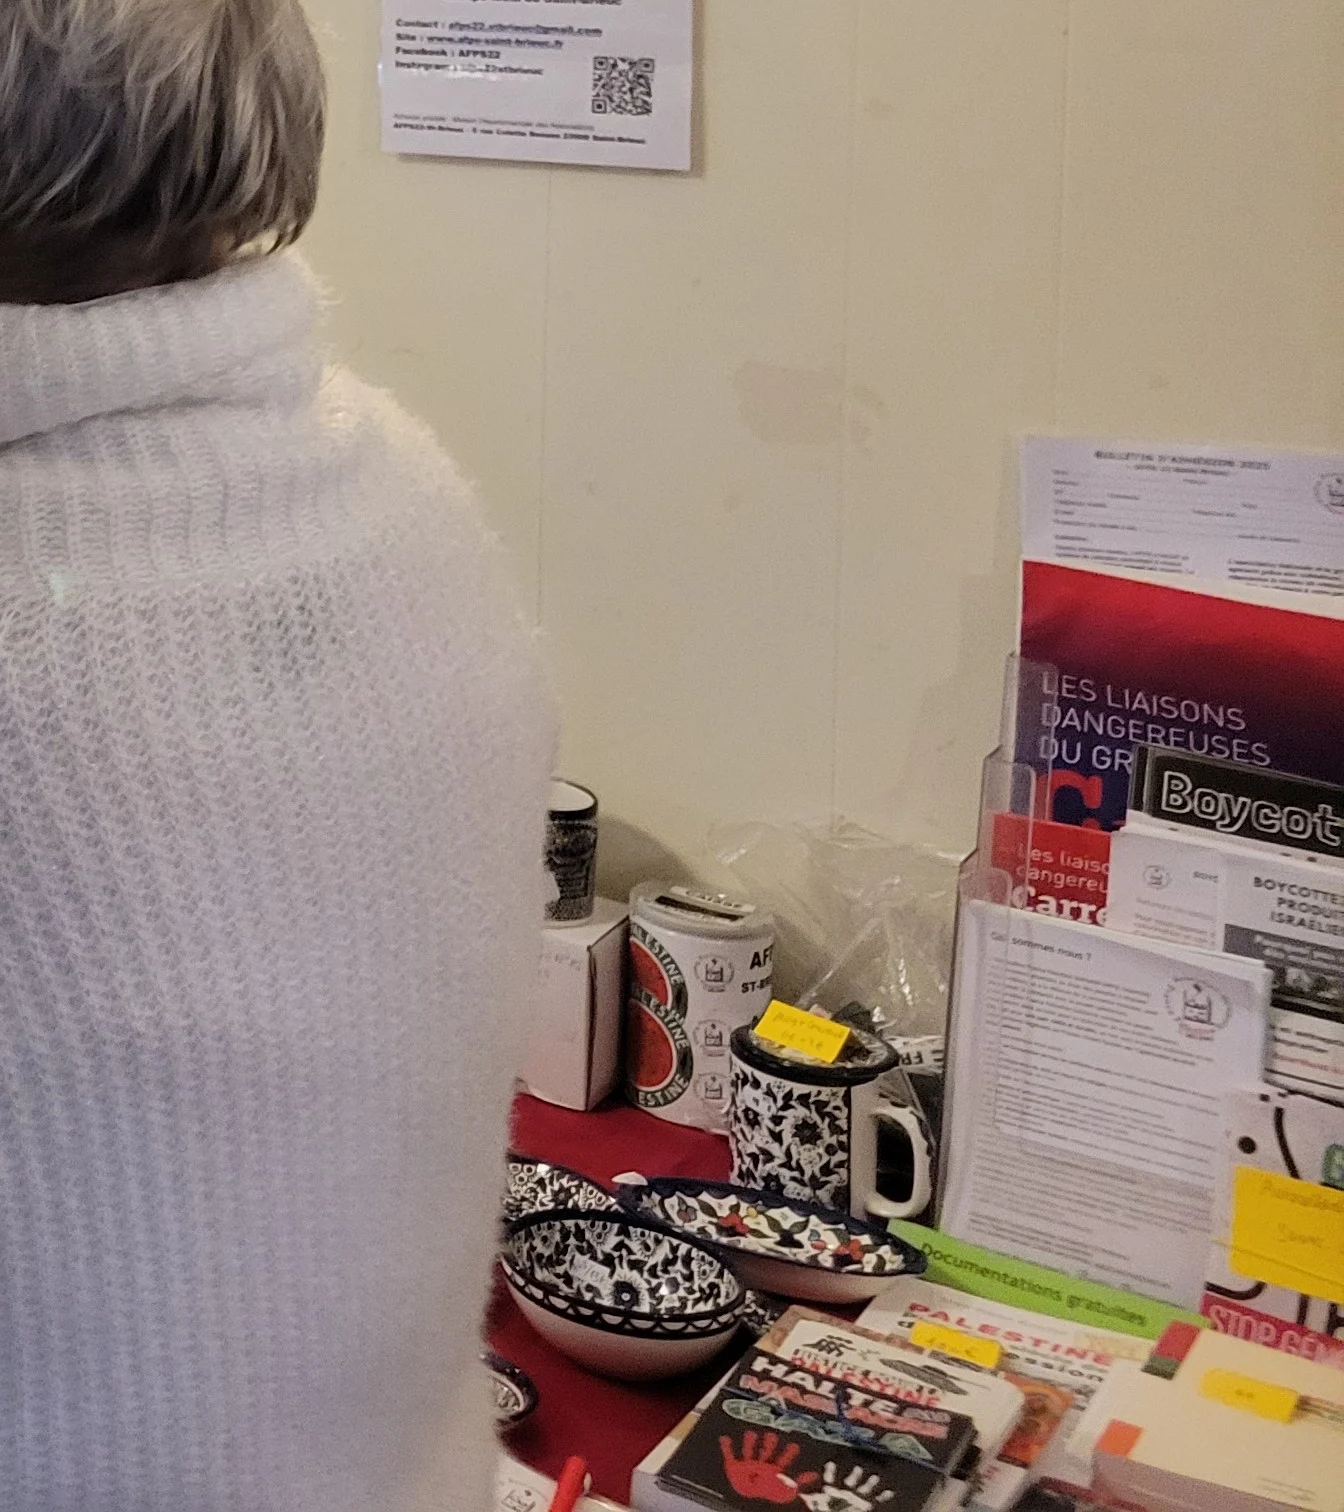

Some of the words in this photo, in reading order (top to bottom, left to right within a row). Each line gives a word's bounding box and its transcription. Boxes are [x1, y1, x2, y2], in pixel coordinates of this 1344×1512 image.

[1041, 671, 1098, 702] LES
[1106, 684, 1247, 731] LIAISONS
[1040, 702, 1272, 767] DANGEREUSES
[1040, 735, 1082, 765] DU
[1012, 937, 1055, 953] sommes
[1058, 948, 1084, 961] nous
[920, 1242, 1063, 1302] Documentations
[908, 1301, 1113, 1367] PALESTINE
[750, 1355, 900, 1415] HALTE
